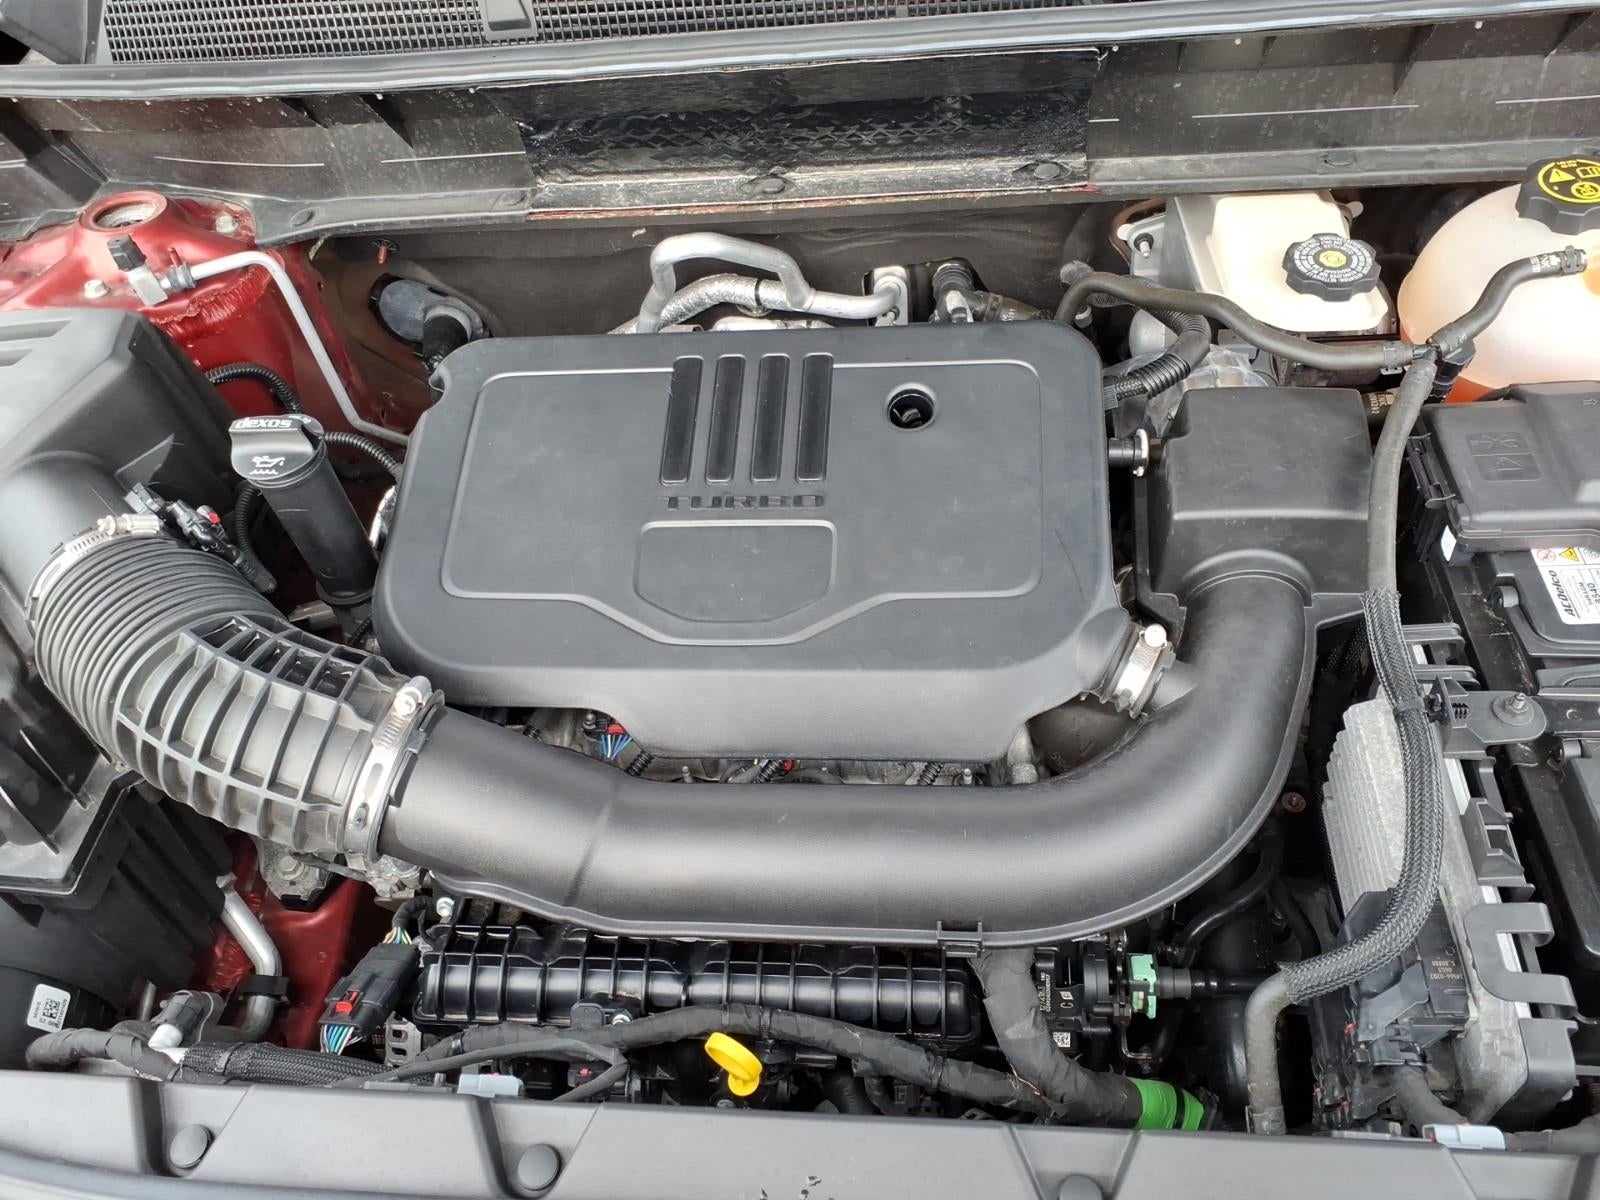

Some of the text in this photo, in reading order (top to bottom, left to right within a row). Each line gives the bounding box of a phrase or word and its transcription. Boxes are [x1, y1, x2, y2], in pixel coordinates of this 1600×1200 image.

[235, 417, 293, 429] dexos
[660, 494, 825, 511] TURBO
[1548, 569, 1576, 617] ACDelco
